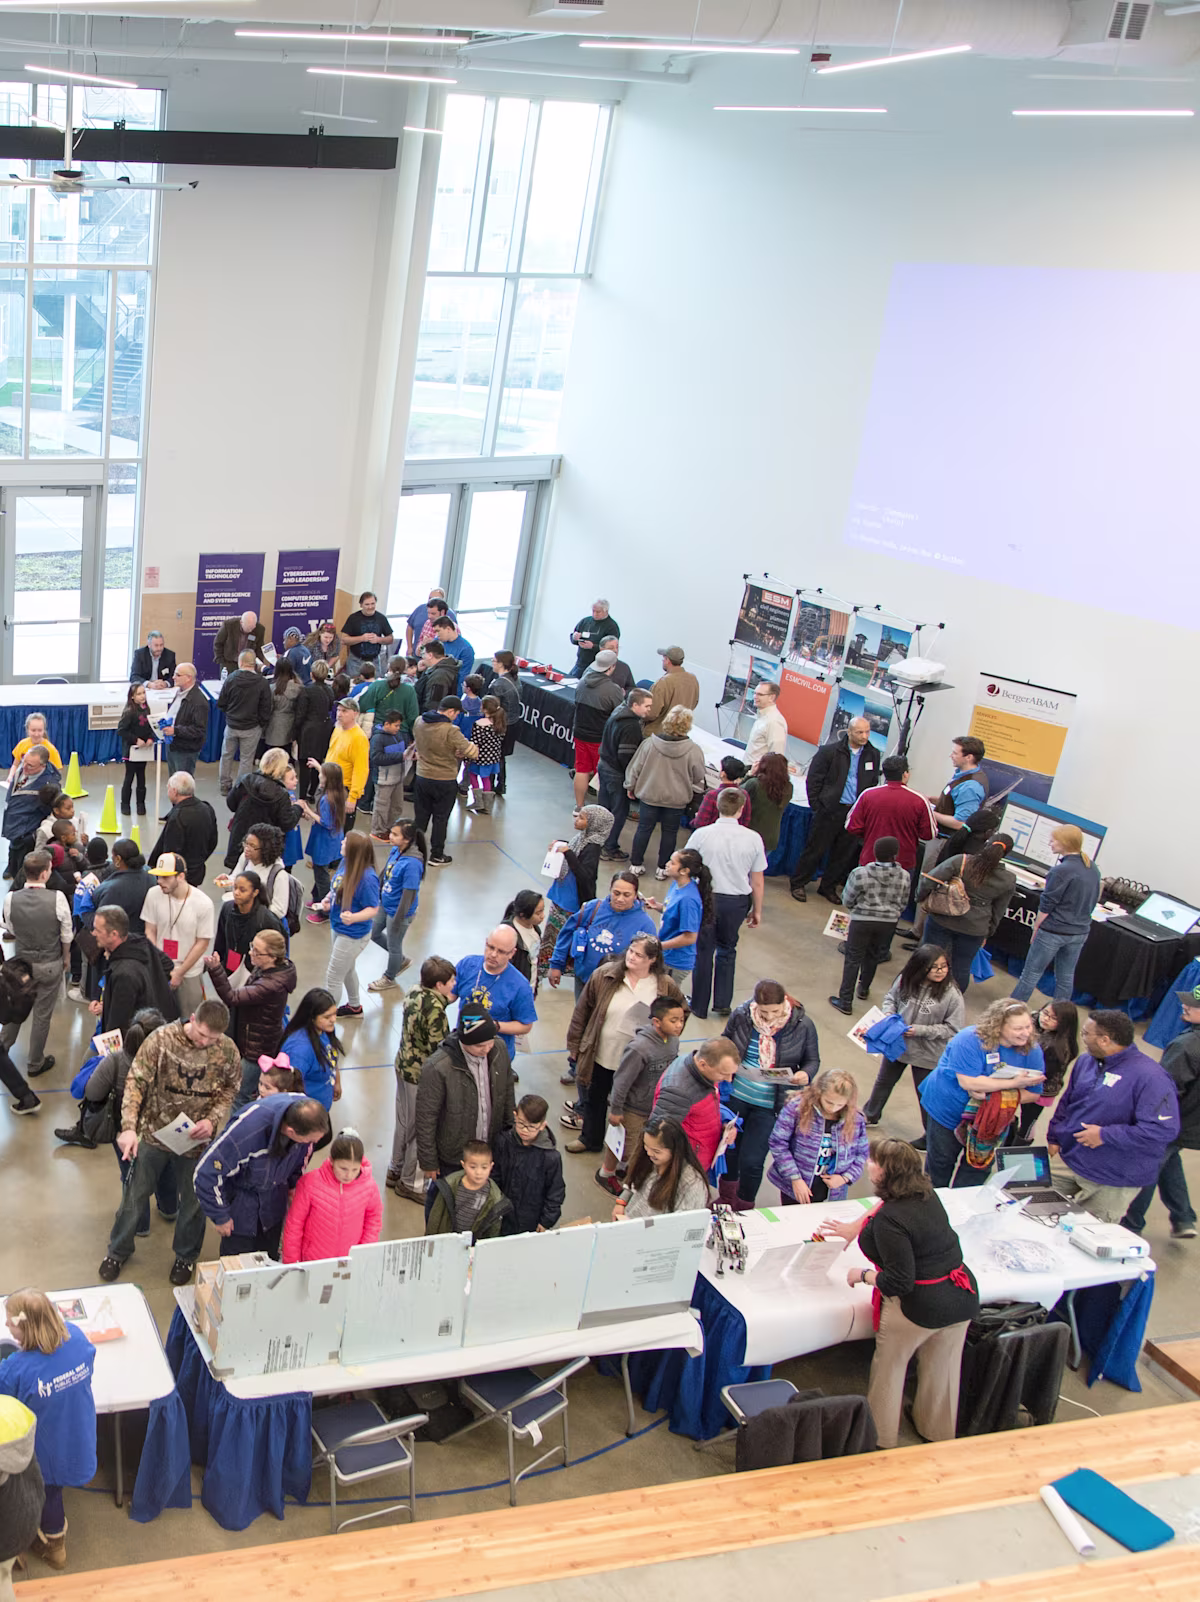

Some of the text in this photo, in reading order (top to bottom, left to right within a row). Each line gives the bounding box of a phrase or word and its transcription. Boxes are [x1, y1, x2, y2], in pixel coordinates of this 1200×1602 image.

[283, 570, 325, 578] CYBERSECURITY
[764, 591, 790, 606] ESM
[785, 673, 827, 694] ESMCIVIL.COM
[1001, 689, 1060, 711] BergerABAM
[541, 715, 576, 750] Grou
